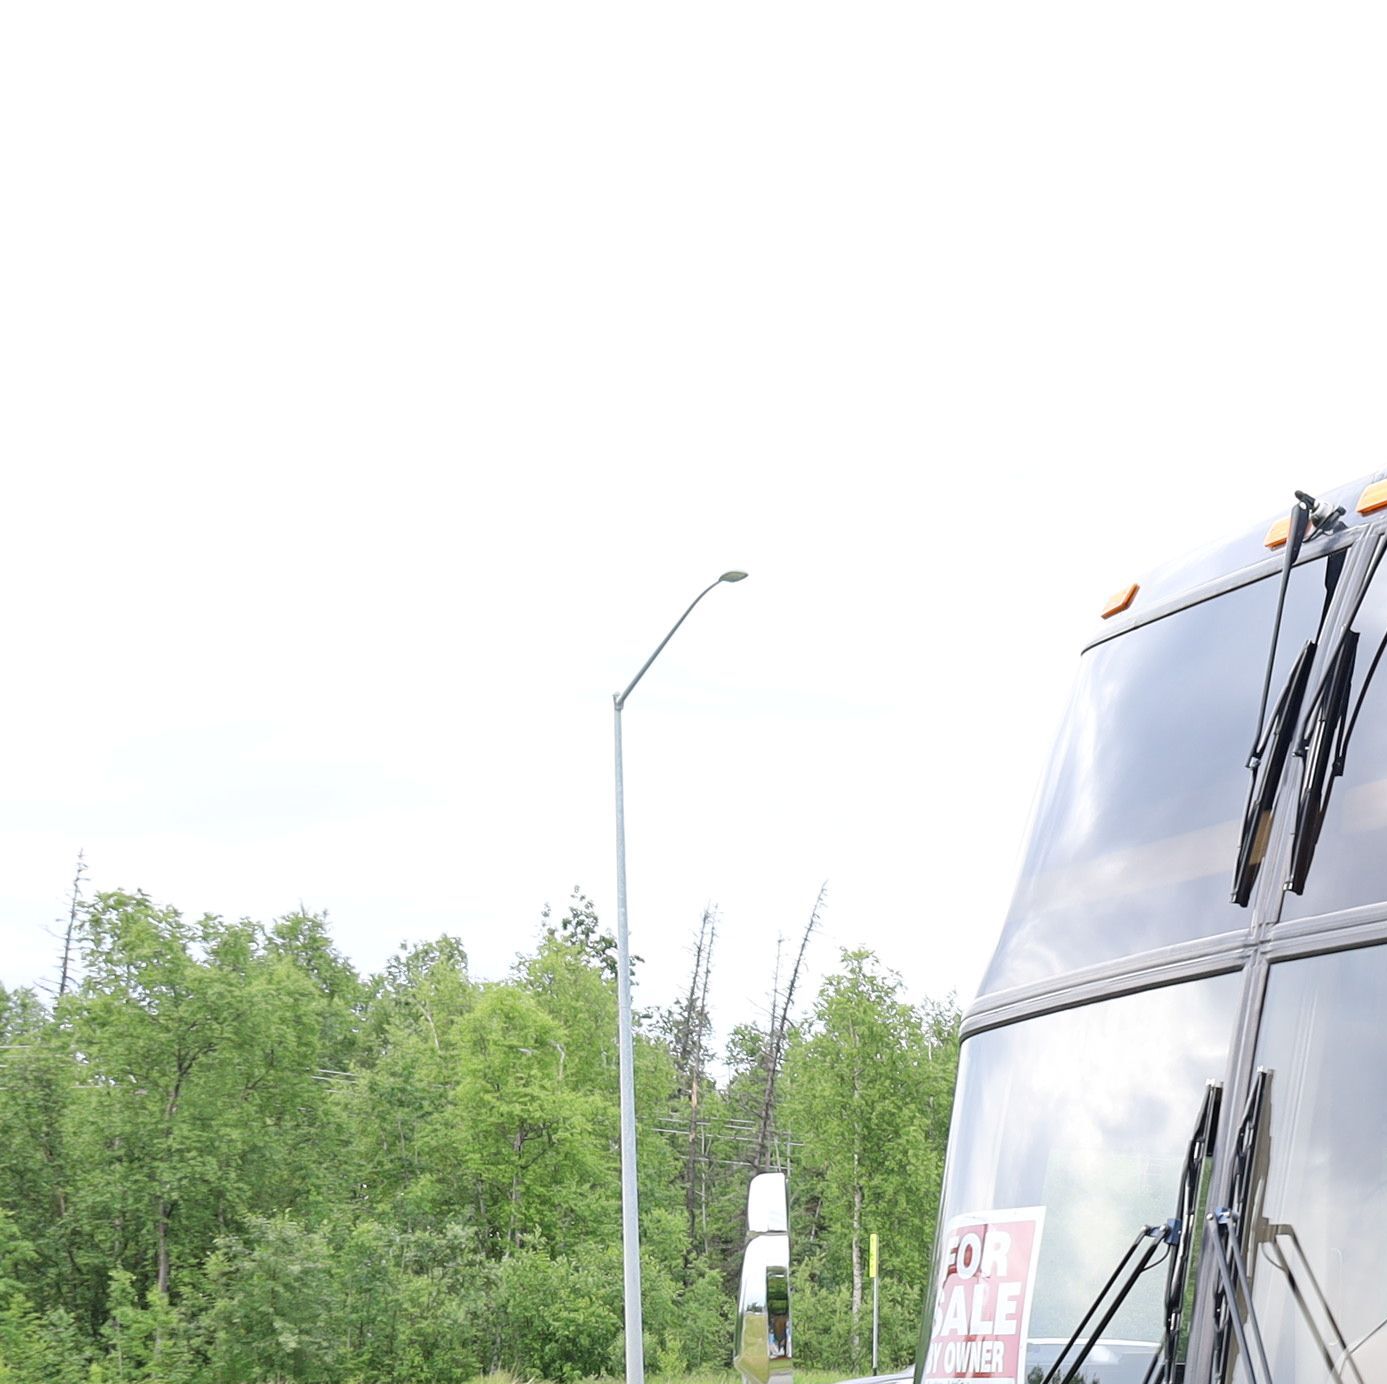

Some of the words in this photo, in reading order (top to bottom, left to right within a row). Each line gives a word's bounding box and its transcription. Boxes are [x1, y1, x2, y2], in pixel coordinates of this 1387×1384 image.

[944, 1230, 1012, 1280] FOR
[932, 1281, 1021, 1339] SALE
[943, 1340, 1005, 1374] OWNER
